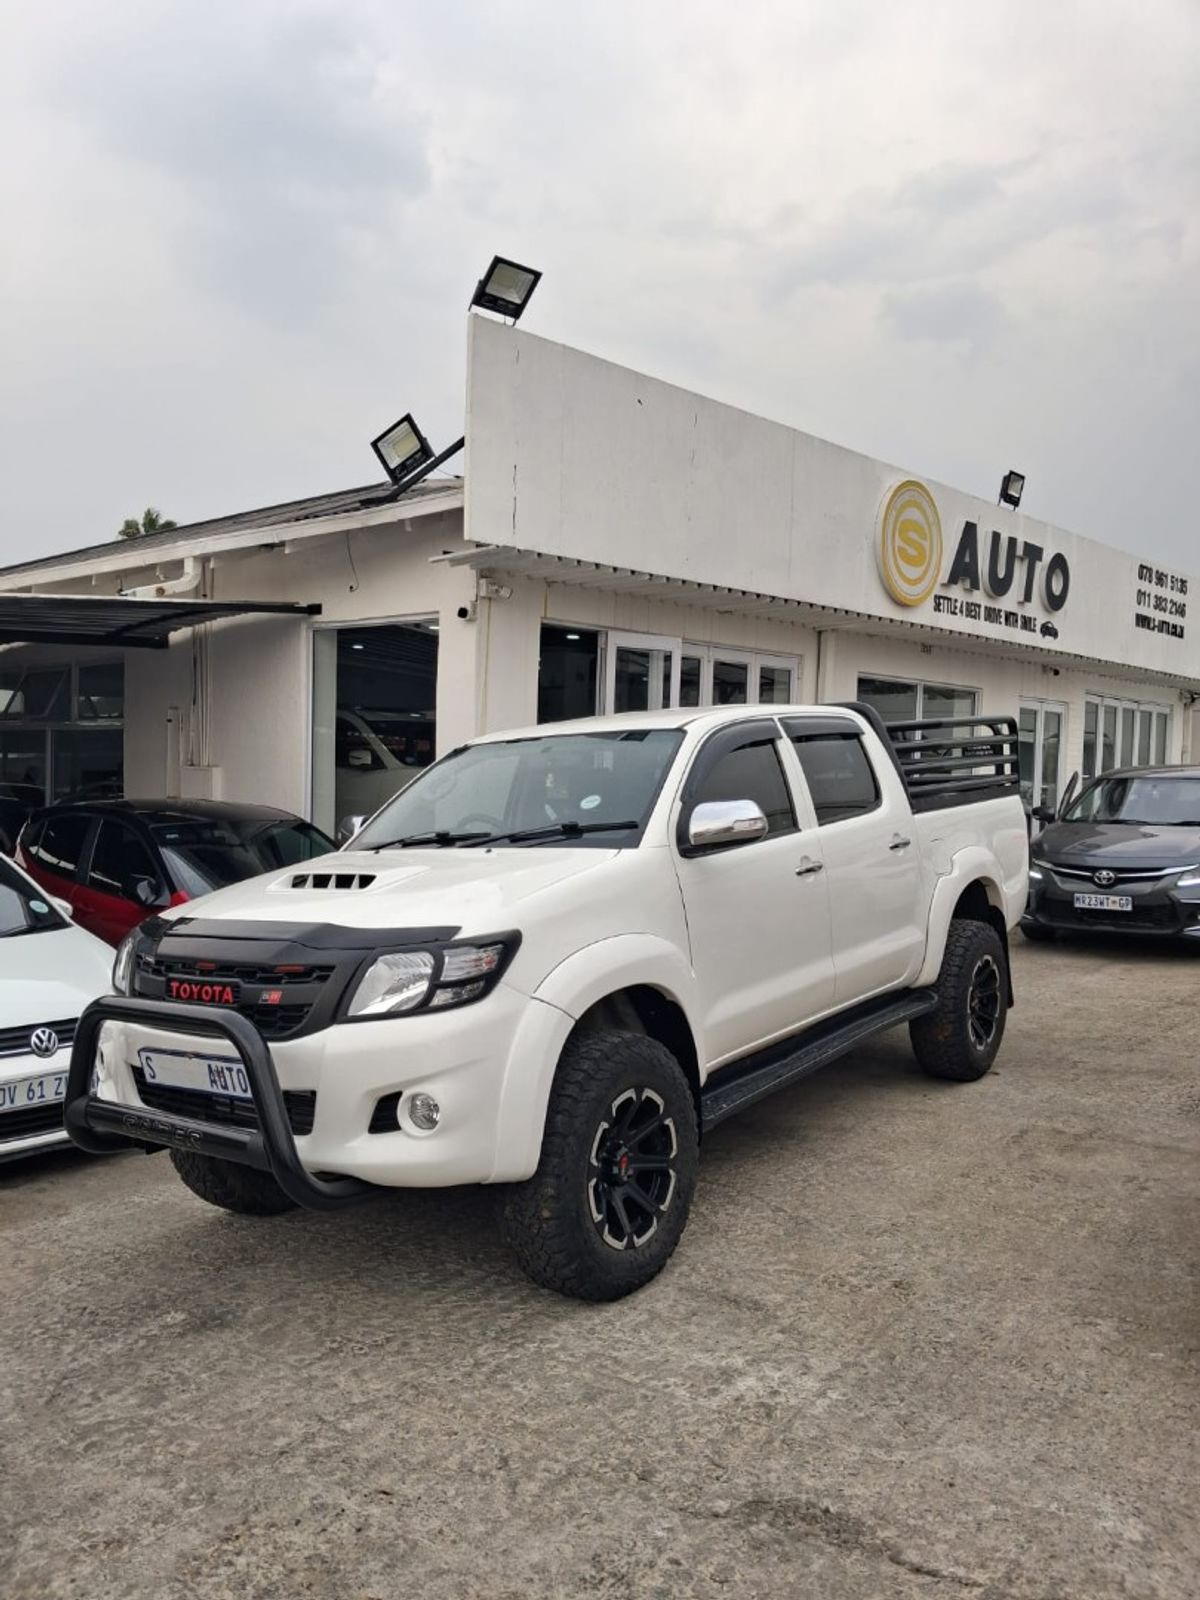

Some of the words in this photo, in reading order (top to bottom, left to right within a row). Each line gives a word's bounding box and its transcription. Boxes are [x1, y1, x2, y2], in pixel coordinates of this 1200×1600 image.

[898, 519, 928, 568] S
[946, 519, 1070, 612] AUTO
[933, 594, 958, 616] SETTLE
[959, 600, 964, 617] 4
[965, 601, 981, 621] BEST
[984, 605, 1003, 625] DRIVE
[1004, 610, 1019, 629] WITH
[1020, 614, 1037, 633] SMILE
[1136, 588, 1151, 608] 011
[170, 980, 234, 1004] TOYOTA
[26, 1080, 46, 1101] 61
[54, 1076, 69, 1097] Z
[145, 1056, 156, 1080] S
[207, 1063, 249, 1094] AUTO
